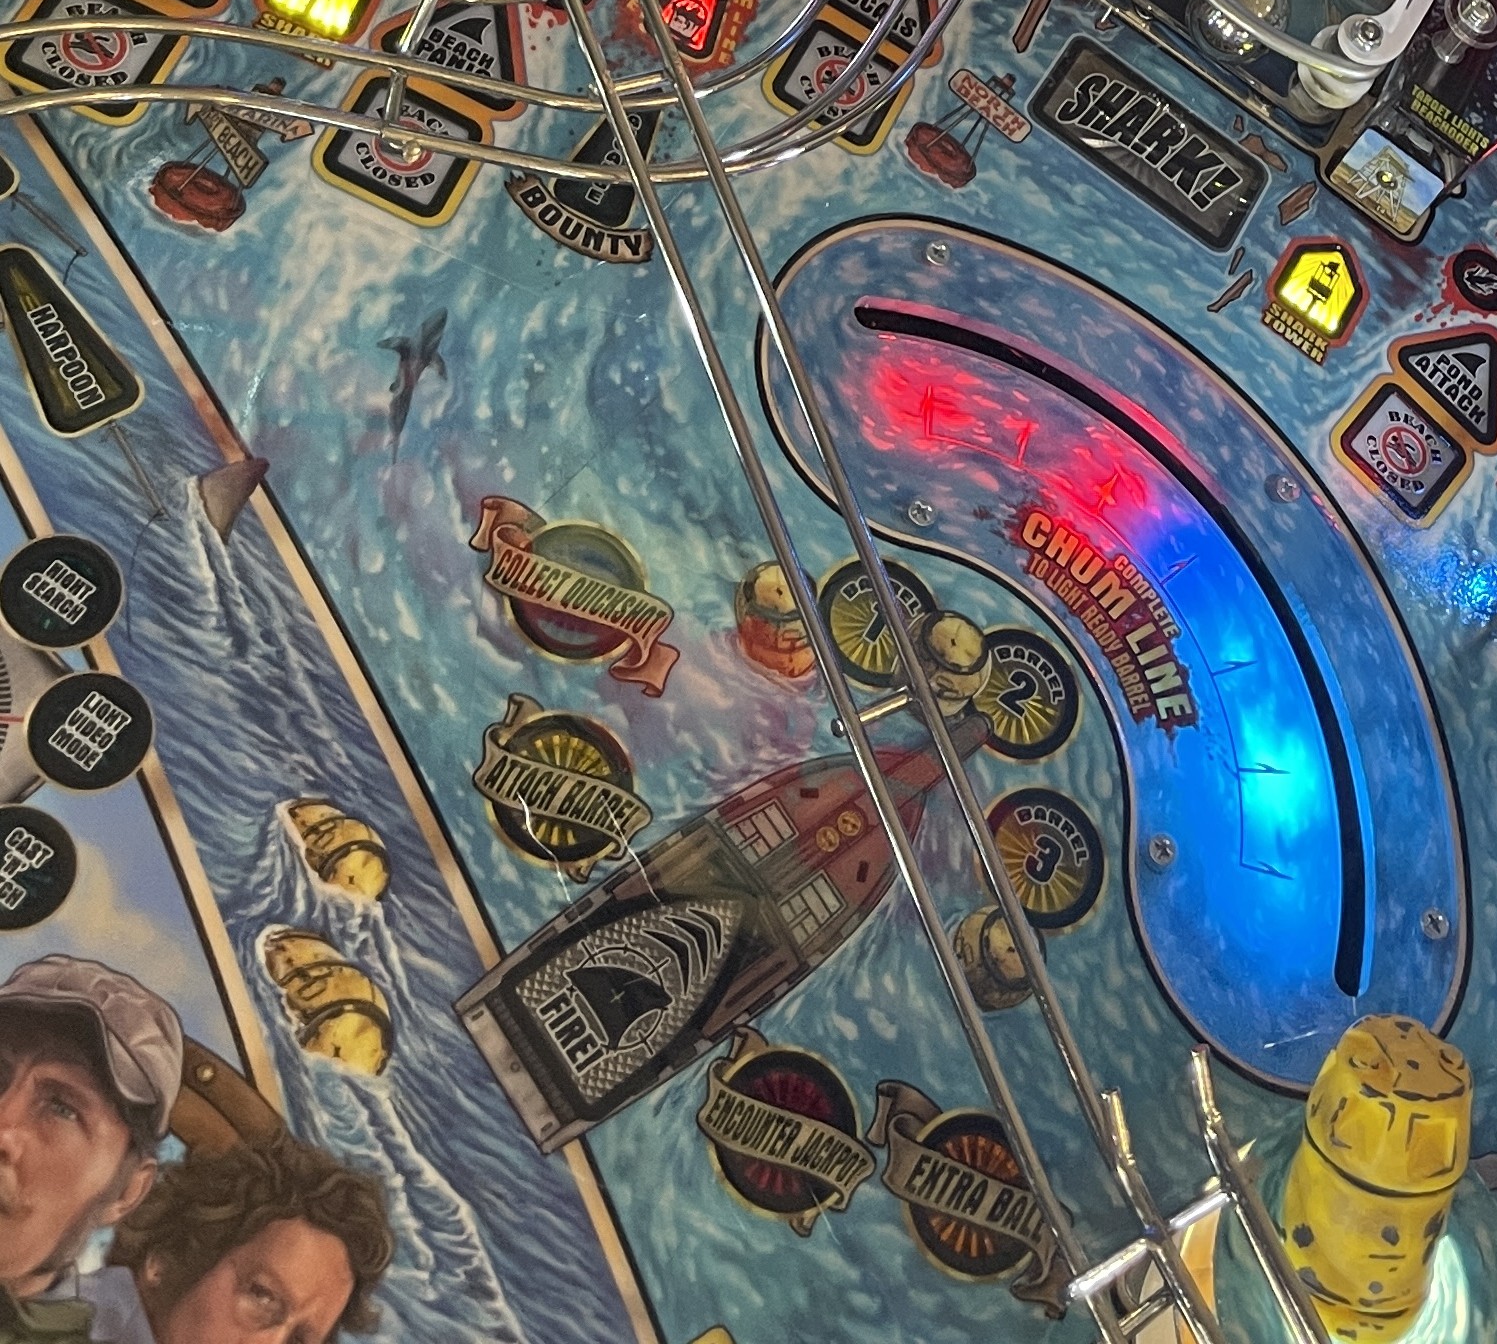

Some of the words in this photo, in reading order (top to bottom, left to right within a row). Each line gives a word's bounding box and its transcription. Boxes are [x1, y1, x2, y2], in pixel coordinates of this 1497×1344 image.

[41, 41, 129, 87] CLOSED
[429, 28, 495, 68] BEACH
[956, 87, 1017, 137] BEACH
[963, 75, 1026, 129] NORTH
[1410, 100, 1480, 156] BEACHGOER
[1412, 85, 1452, 119] TARGET
[1450, 112, 1490, 150] LIGHTS
[217, 123, 257, 181] BEACH
[355, 141, 436, 190] CLOSED
[1055, 72, 1241, 212] SHARK!
[521, 185, 643, 257] BOUNTY
[1263, 315, 1326, 365] TOWER
[1270, 304, 1327, 351] SHARK
[28, 302, 105, 410] HARPOON
[1437, 351, 1484, 399] POND
[1415, 355, 1488, 425] ATTACK
[1365, 434, 1427, 494] CLOSED
[1388, 410, 1443, 465] BEACH
[23, 570, 85, 627] SEARCH
[44, 559, 97, 606] NIGHT
[491, 550, 567, 603] COLLECT
[559, 575, 669, 636] QUICKSHOT
[1113, 554, 1181, 639] COMPLETE
[1022, 512, 1137, 621] CHUM
[1125, 622, 1194, 720] LINE
[1028, 553, 1050, 579] TO
[1047, 567, 1089, 611] LIGHT
[1080, 604, 1124, 653] READY
[1114, 651, 1152, 715] BARREL
[994, 645, 1066, 704] BARREL
[997, 669, 1039, 720] 2
[67, 710, 113, 753] VIDEO
[77, 692, 132, 739] LIGHT
[51, 725, 104, 771] MODE
[485, 754, 562, 810] ATTACH
[560, 772, 651, 834] BARREL
[5, 827, 54, 869] CAST
[1014, 806, 1091, 867] BARREL
[1023, 834, 1064, 885] 3
[713, 1087, 803, 1163] ENCOUNTER
[799, 1125, 867, 1187] JACKPOT
[910, 1162, 986, 1214] EXTRA
[986, 1181, 1047, 1245] BALL
